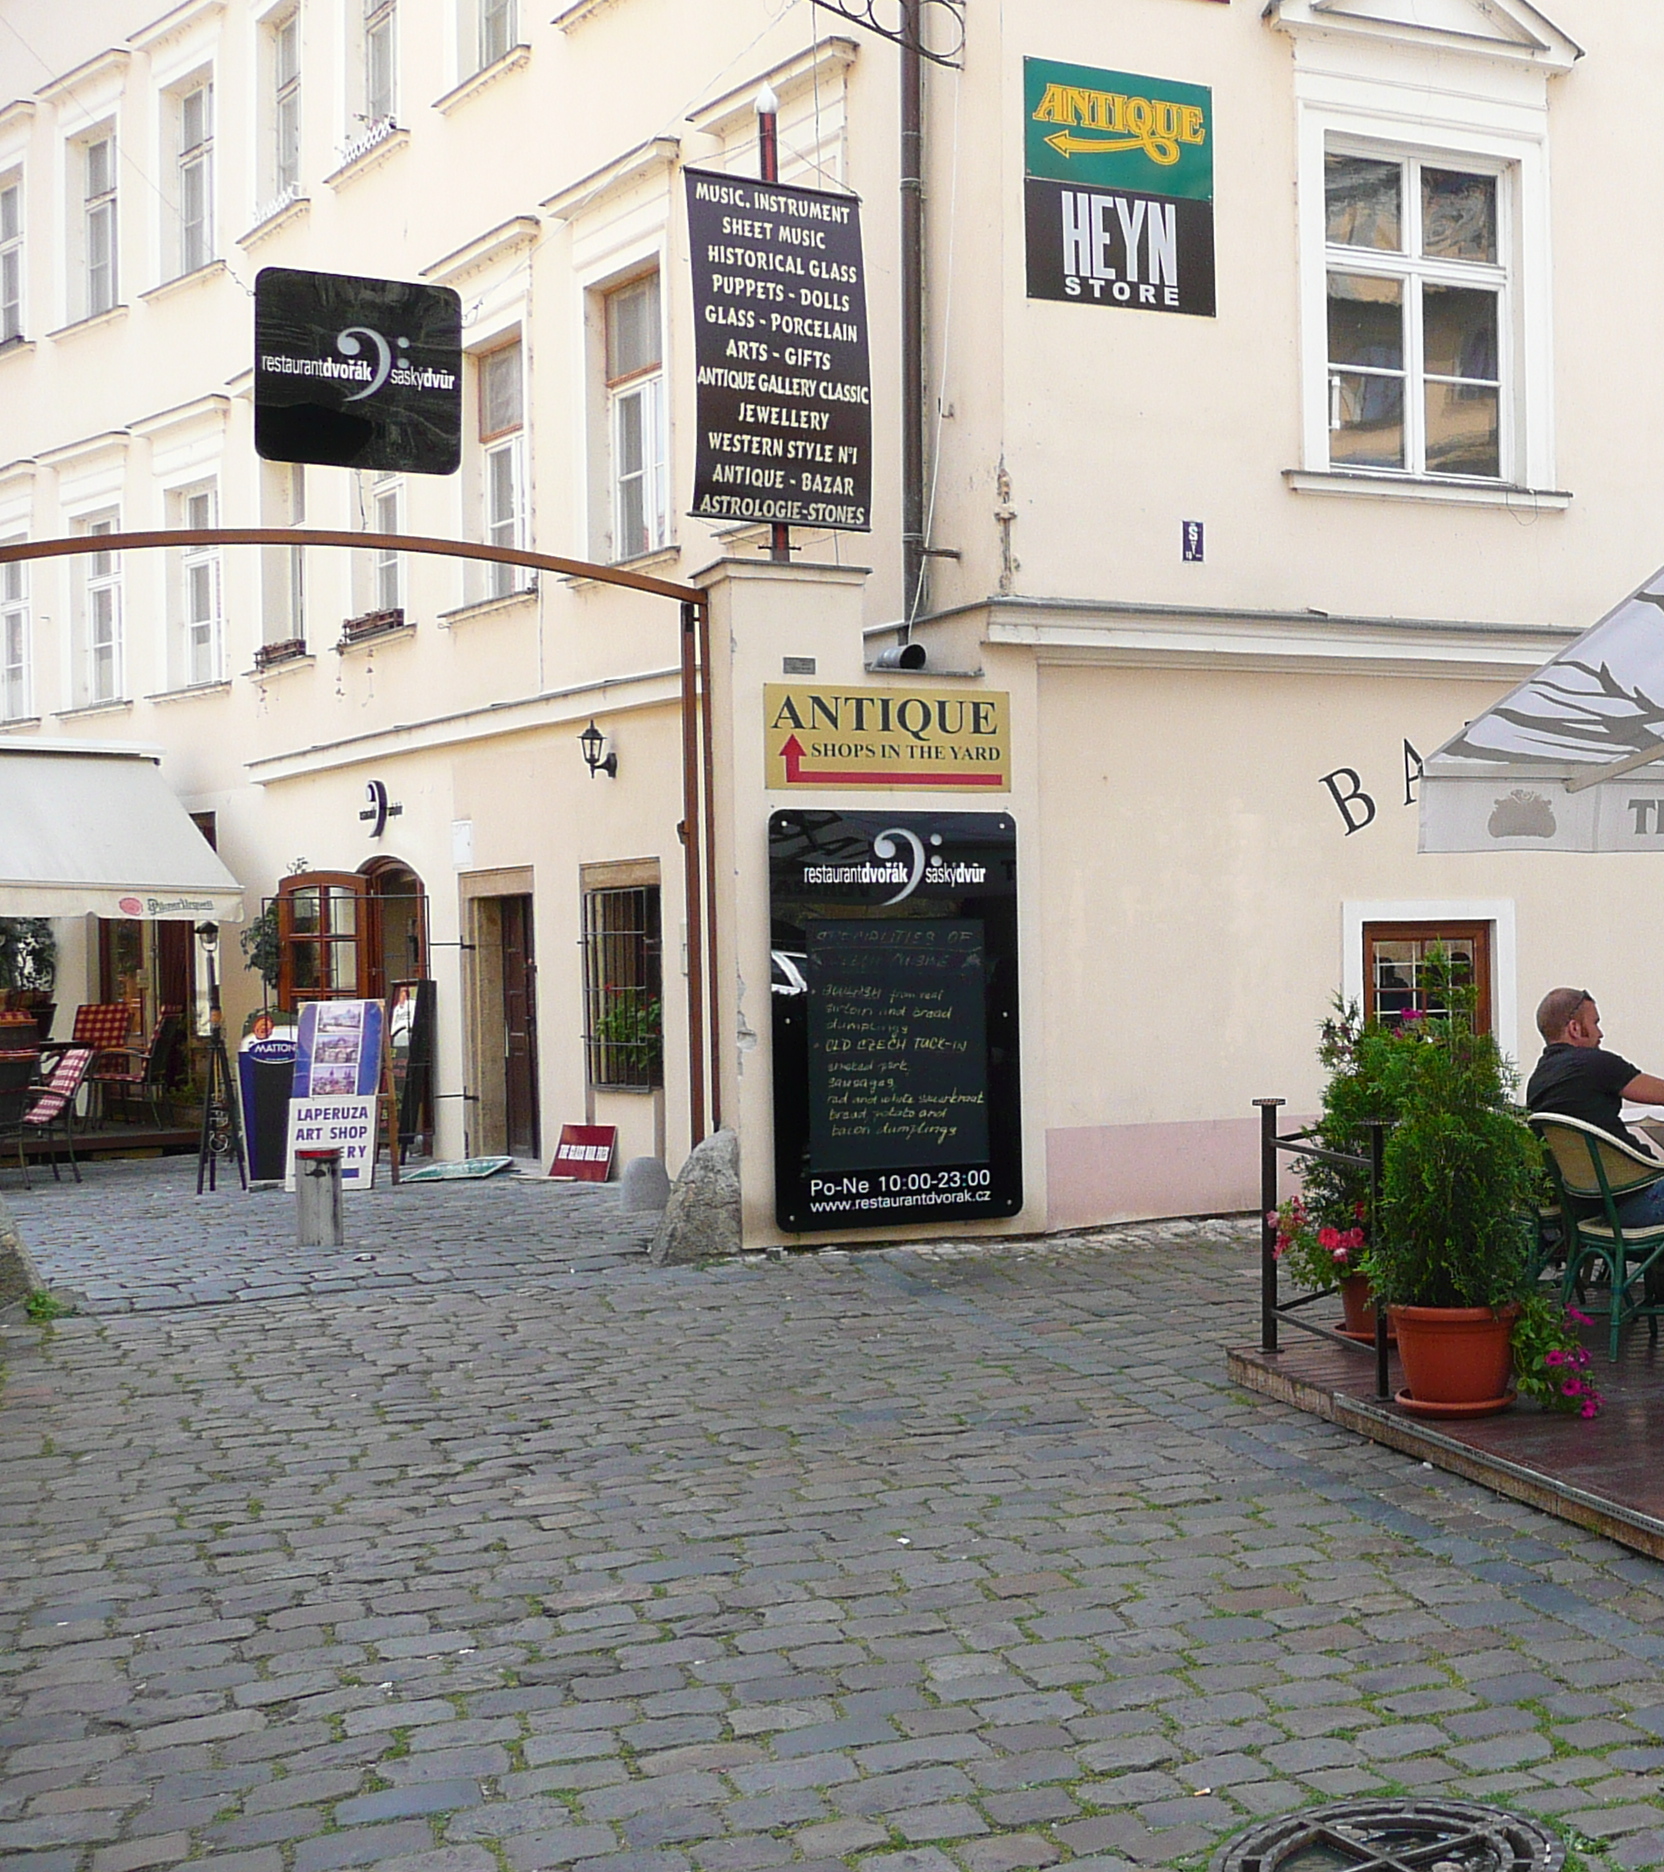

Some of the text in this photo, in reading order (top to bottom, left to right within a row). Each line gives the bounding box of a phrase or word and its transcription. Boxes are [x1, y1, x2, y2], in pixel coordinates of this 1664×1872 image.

[1032, 83, 1206, 165] ANTIQUE
[695, 182, 850, 225] MUSIC. INSTRUMENT
[722, 216, 826, 249] SHEET MUSIC
[1061, 190, 1178, 287] HEYN
[707, 245, 857, 284] HISTORICAL GLASS
[712, 273, 784, 301] PUPPETS
[800, 288, 850, 312] DOLLS
[1064, 276, 1180, 306] STORE
[705, 304, 756, 329] GLASS
[770, 313, 858, 343] PORCELAIN
[726, 338, 768, 362] ARTS
[784, 347, 832, 371] GIFTS
[697, 365, 869, 406] ANTIQUE GALLERY CLASSIC
[738, 401, 830, 431] JEWELLERY
[708, 431, 783, 457] WESTERN
[787, 440, 833, 464] STYLE
[712, 463, 785, 490] ANTIQUE
[801, 473, 854, 497] BAZAR
[700, 494, 865, 525] ASTROLOGIE-STONES
[771, 695, 998, 741] ANTIQUE
[811, 742, 1001, 762] SHOPS IN THE YARD
[826, 1038, 967, 1053] OLD CZECH TUCK-IN
[297, 1106, 369, 1122] LAPERUZA
[296, 1126, 368, 1141] ART SHOP
[810, 1170, 991, 1197] Po-Ne 10:00-23:00
[810, 1189, 992, 1213] www.restaurantdvorak.cz
